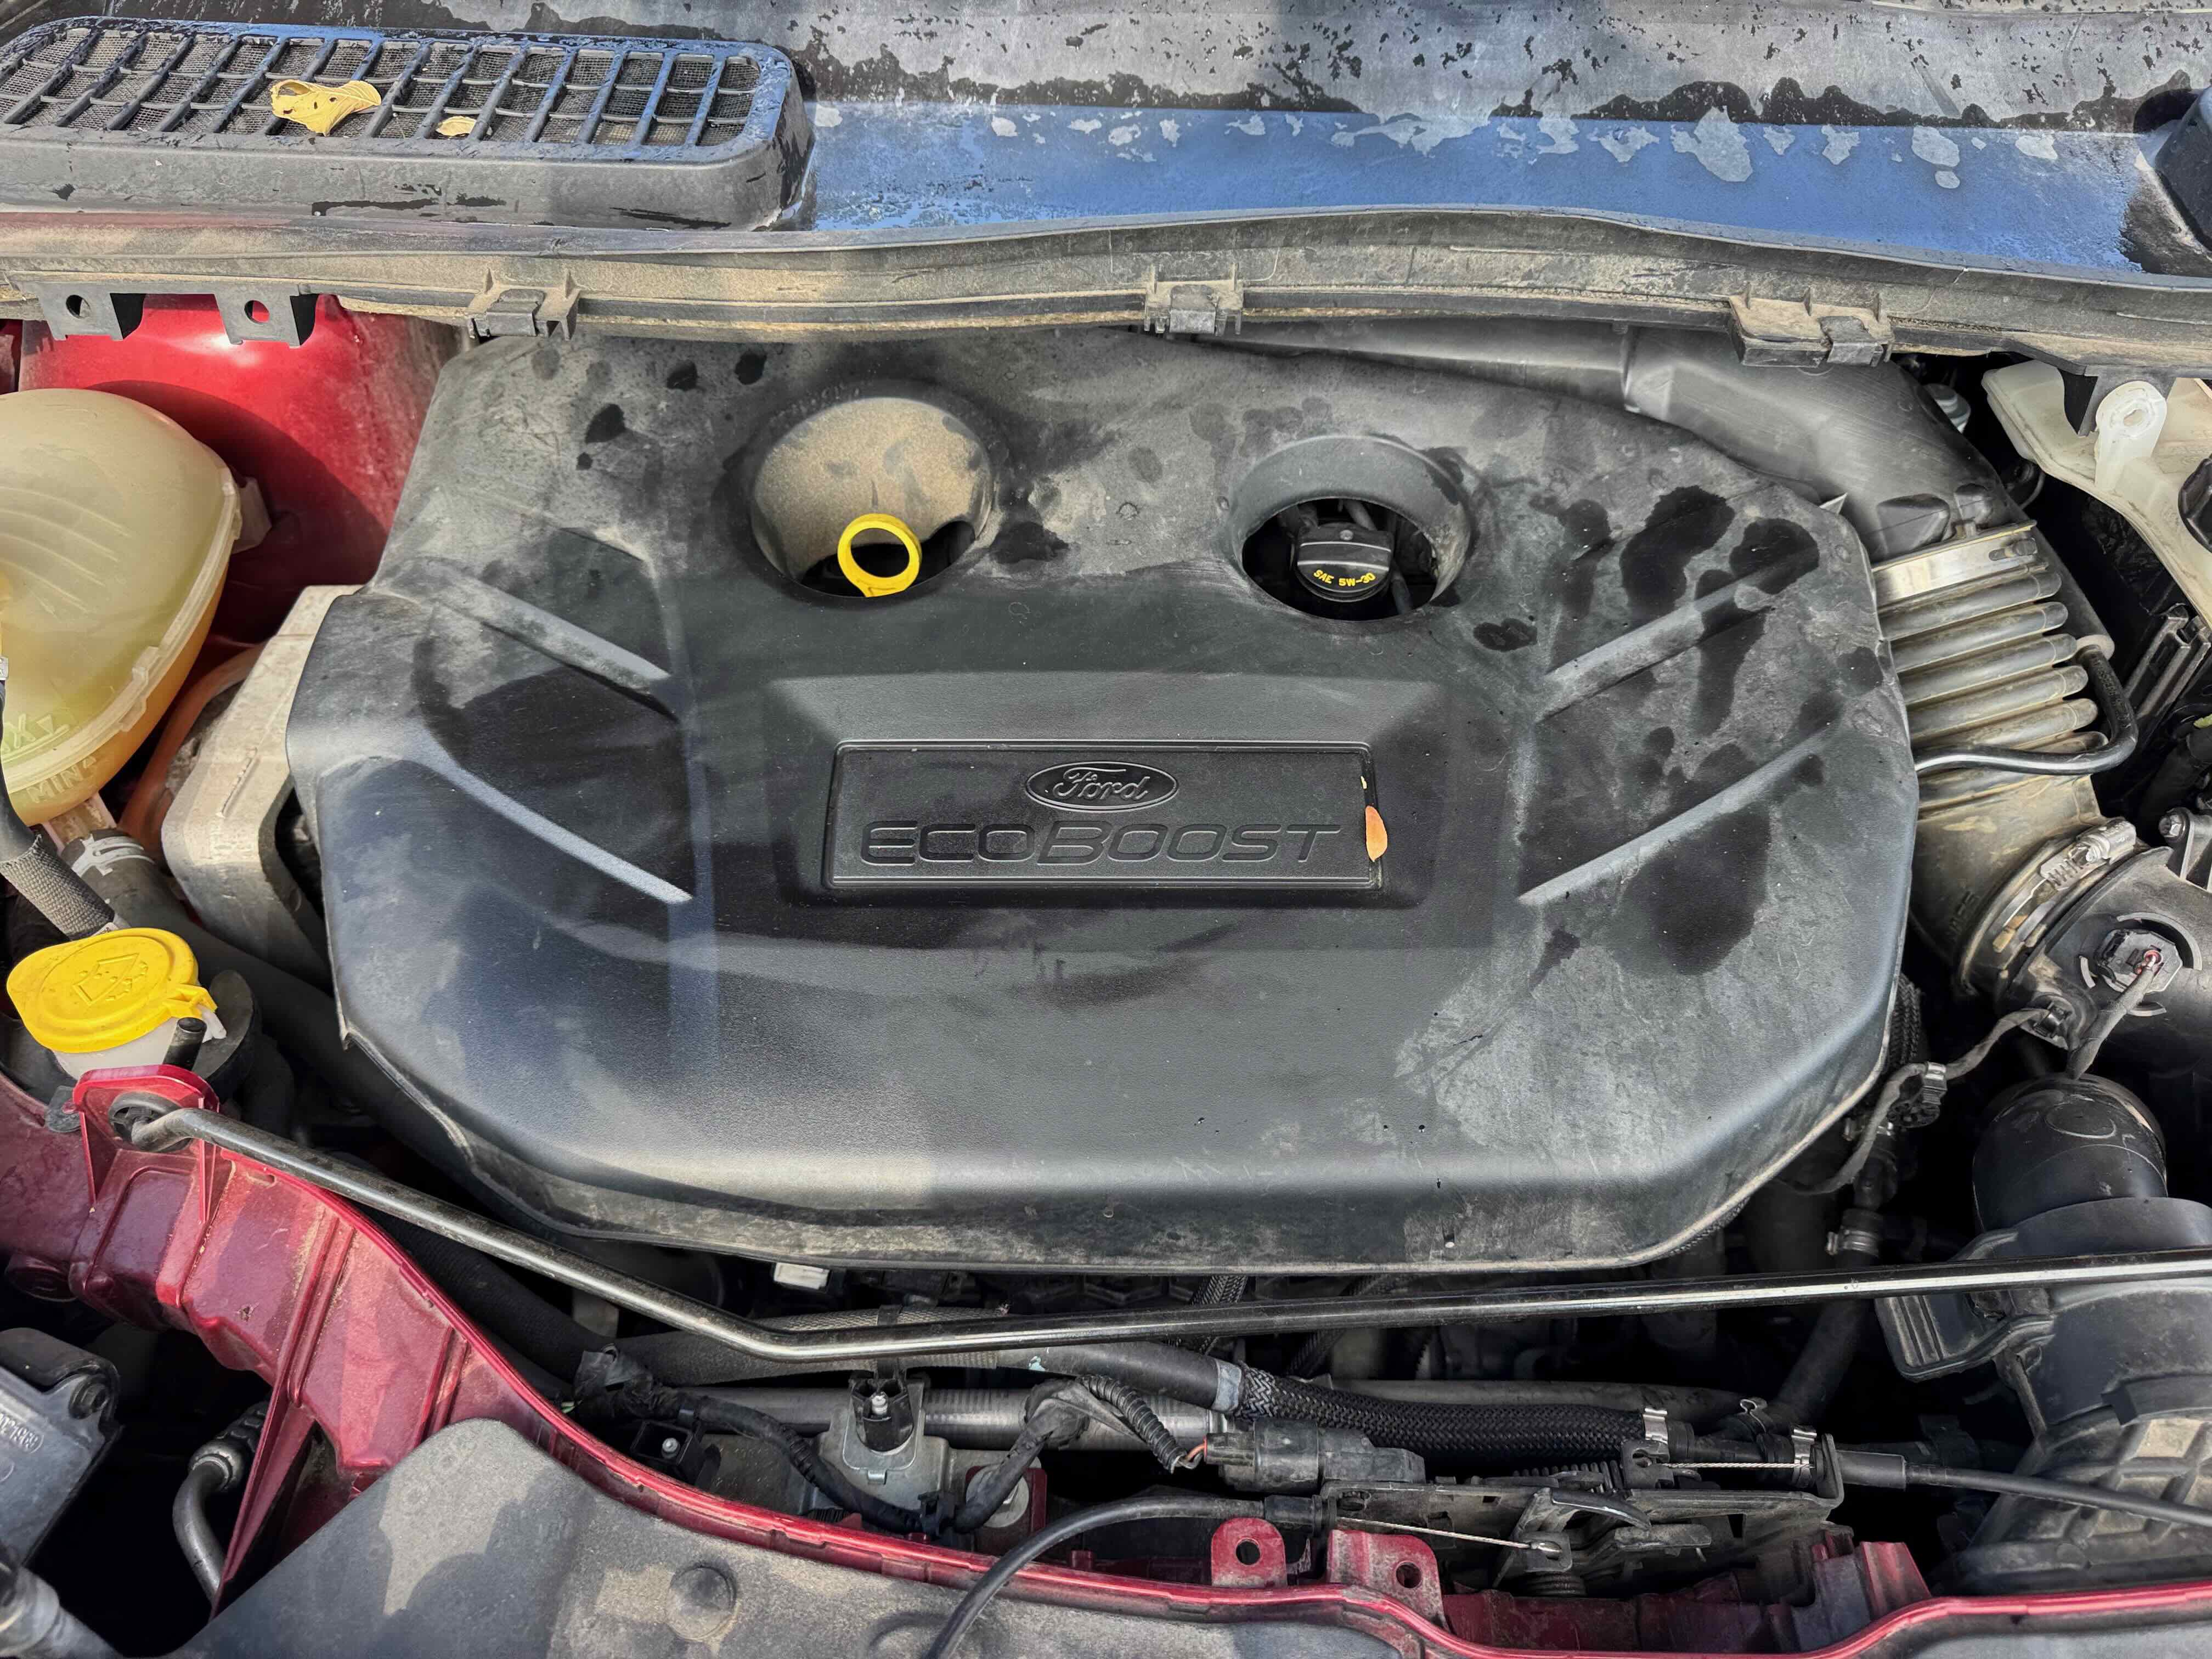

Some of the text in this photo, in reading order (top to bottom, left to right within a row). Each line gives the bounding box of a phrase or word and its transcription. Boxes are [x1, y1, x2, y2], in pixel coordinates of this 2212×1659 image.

[1313, 569, 1376, 587] SAE 5W-30
[26, 764, 83, 803] MIN
[1052, 767, 1150, 800] Ford
[860, 820, 1341, 867] ECOBOOST
